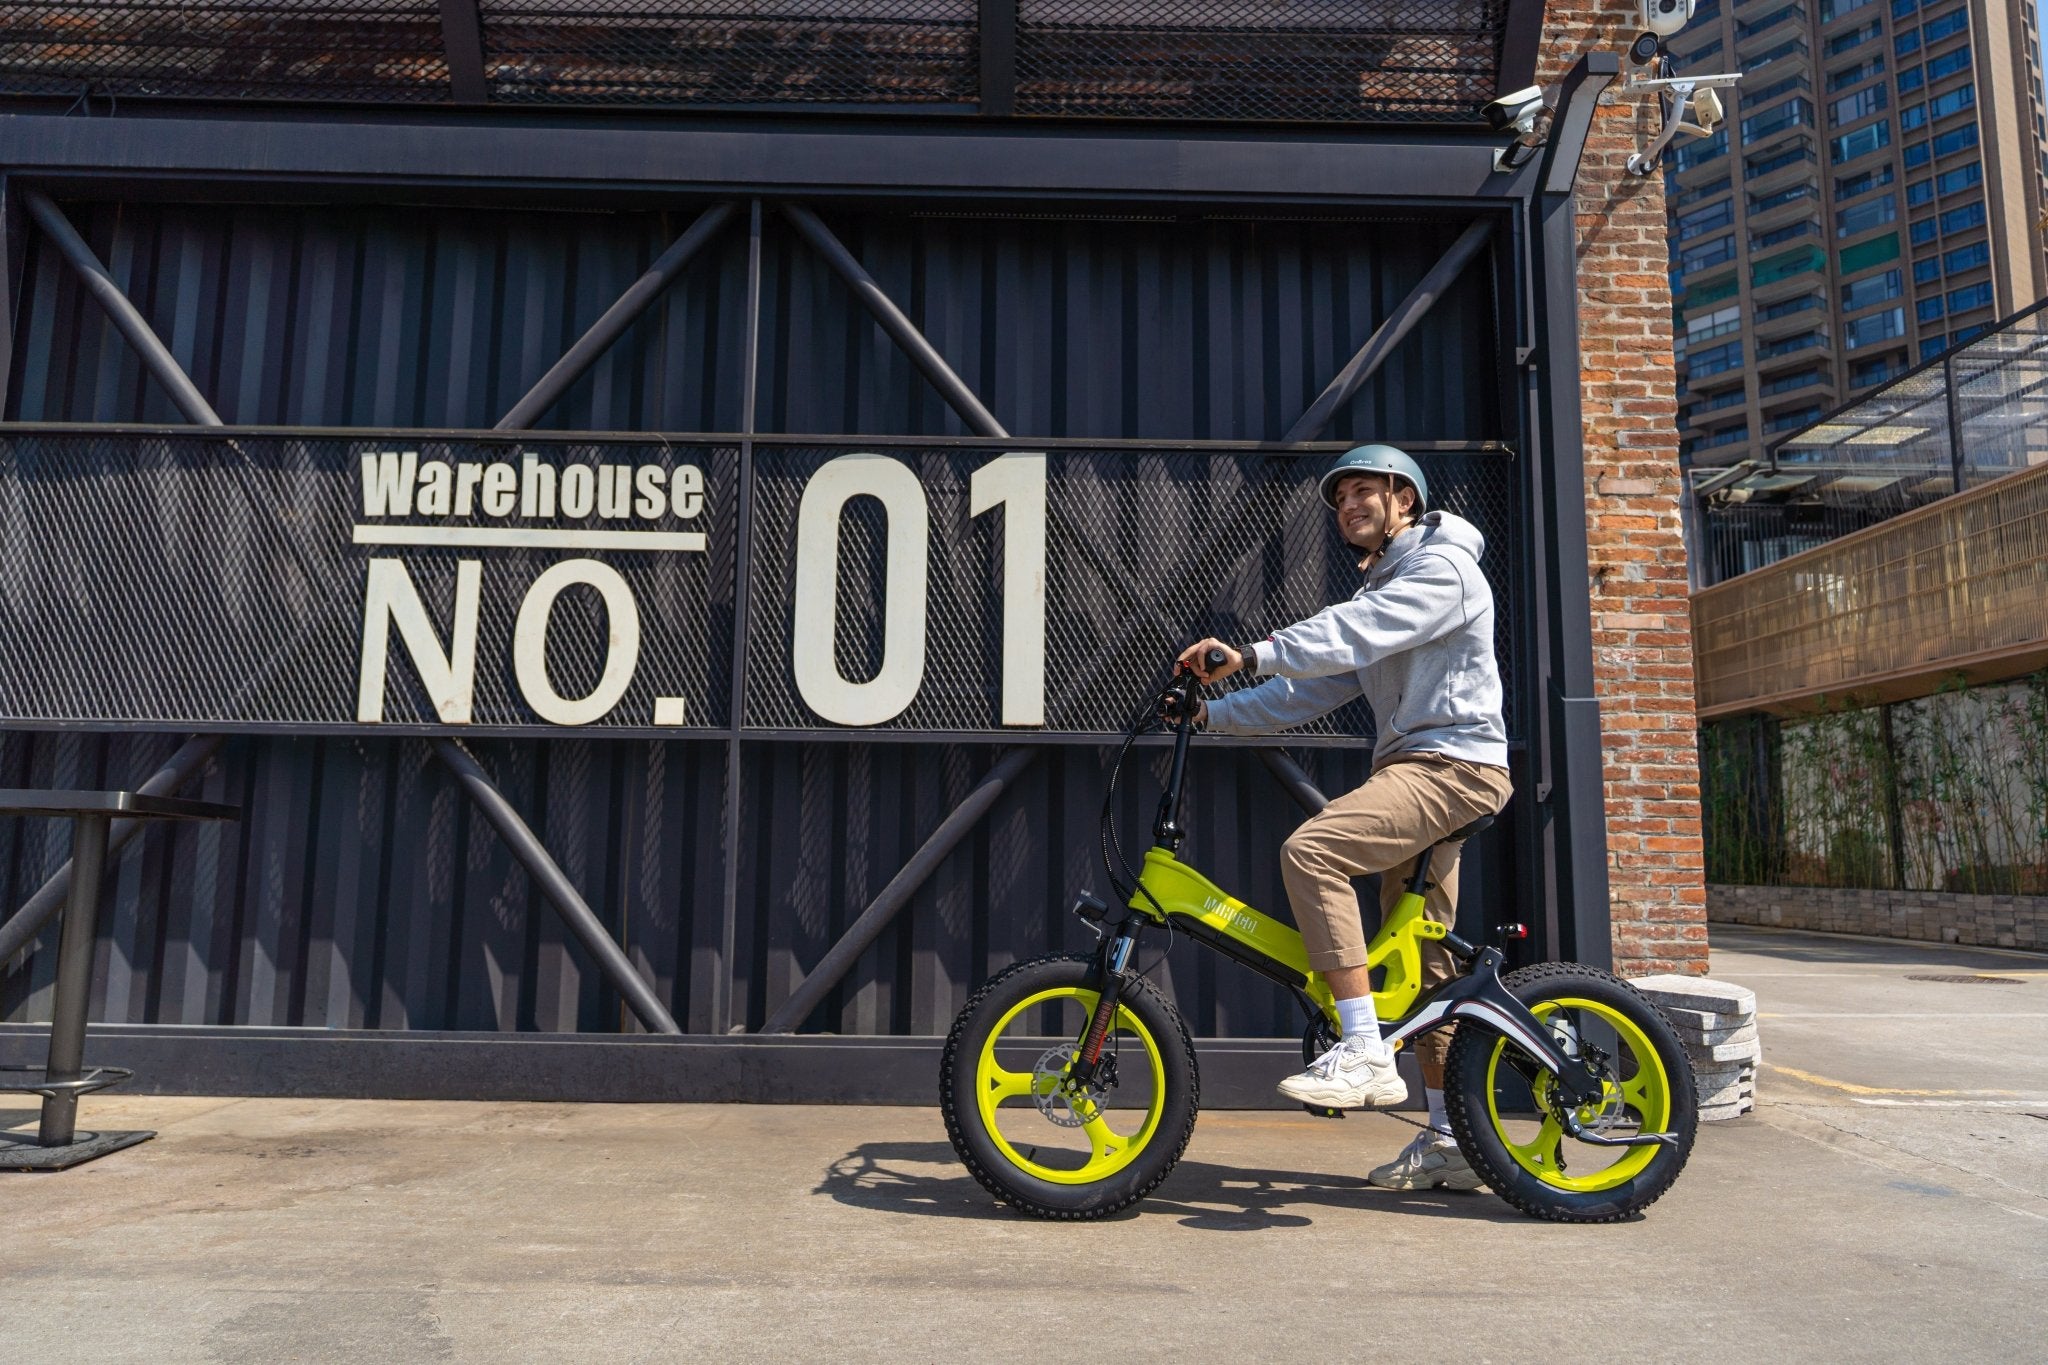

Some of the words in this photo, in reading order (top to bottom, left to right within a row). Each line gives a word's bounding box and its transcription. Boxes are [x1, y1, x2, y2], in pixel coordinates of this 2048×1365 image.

[361, 452, 704, 519] Warehouse
[357, 558, 685, 726] NO.
[793, 452, 1047, 726] 01
